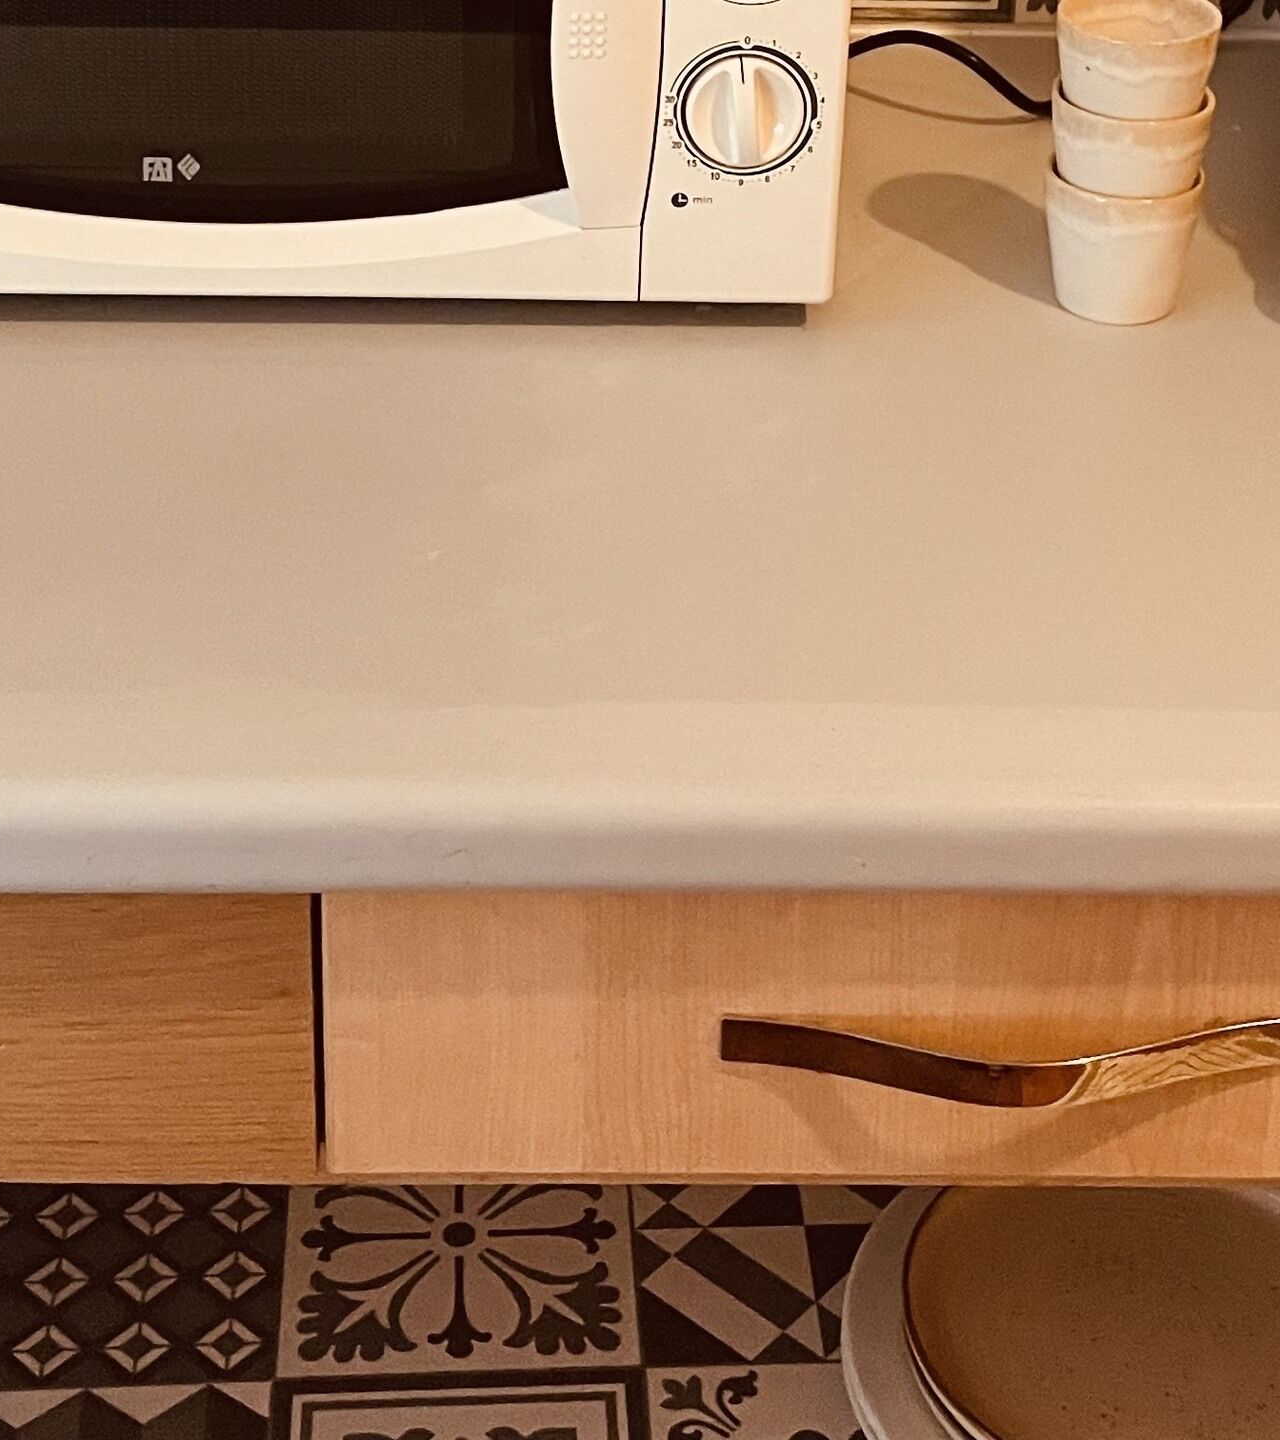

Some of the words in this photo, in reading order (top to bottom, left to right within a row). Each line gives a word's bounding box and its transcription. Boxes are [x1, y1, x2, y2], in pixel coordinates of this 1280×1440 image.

[744, 36, 751, 45] 0
[796, 51, 802, 59] 2
[663, 118, 674, 127] 25
[686, 159, 697, 168] 15
[710, 172, 721, 180] 10
[692, 196, 713, 205] min
